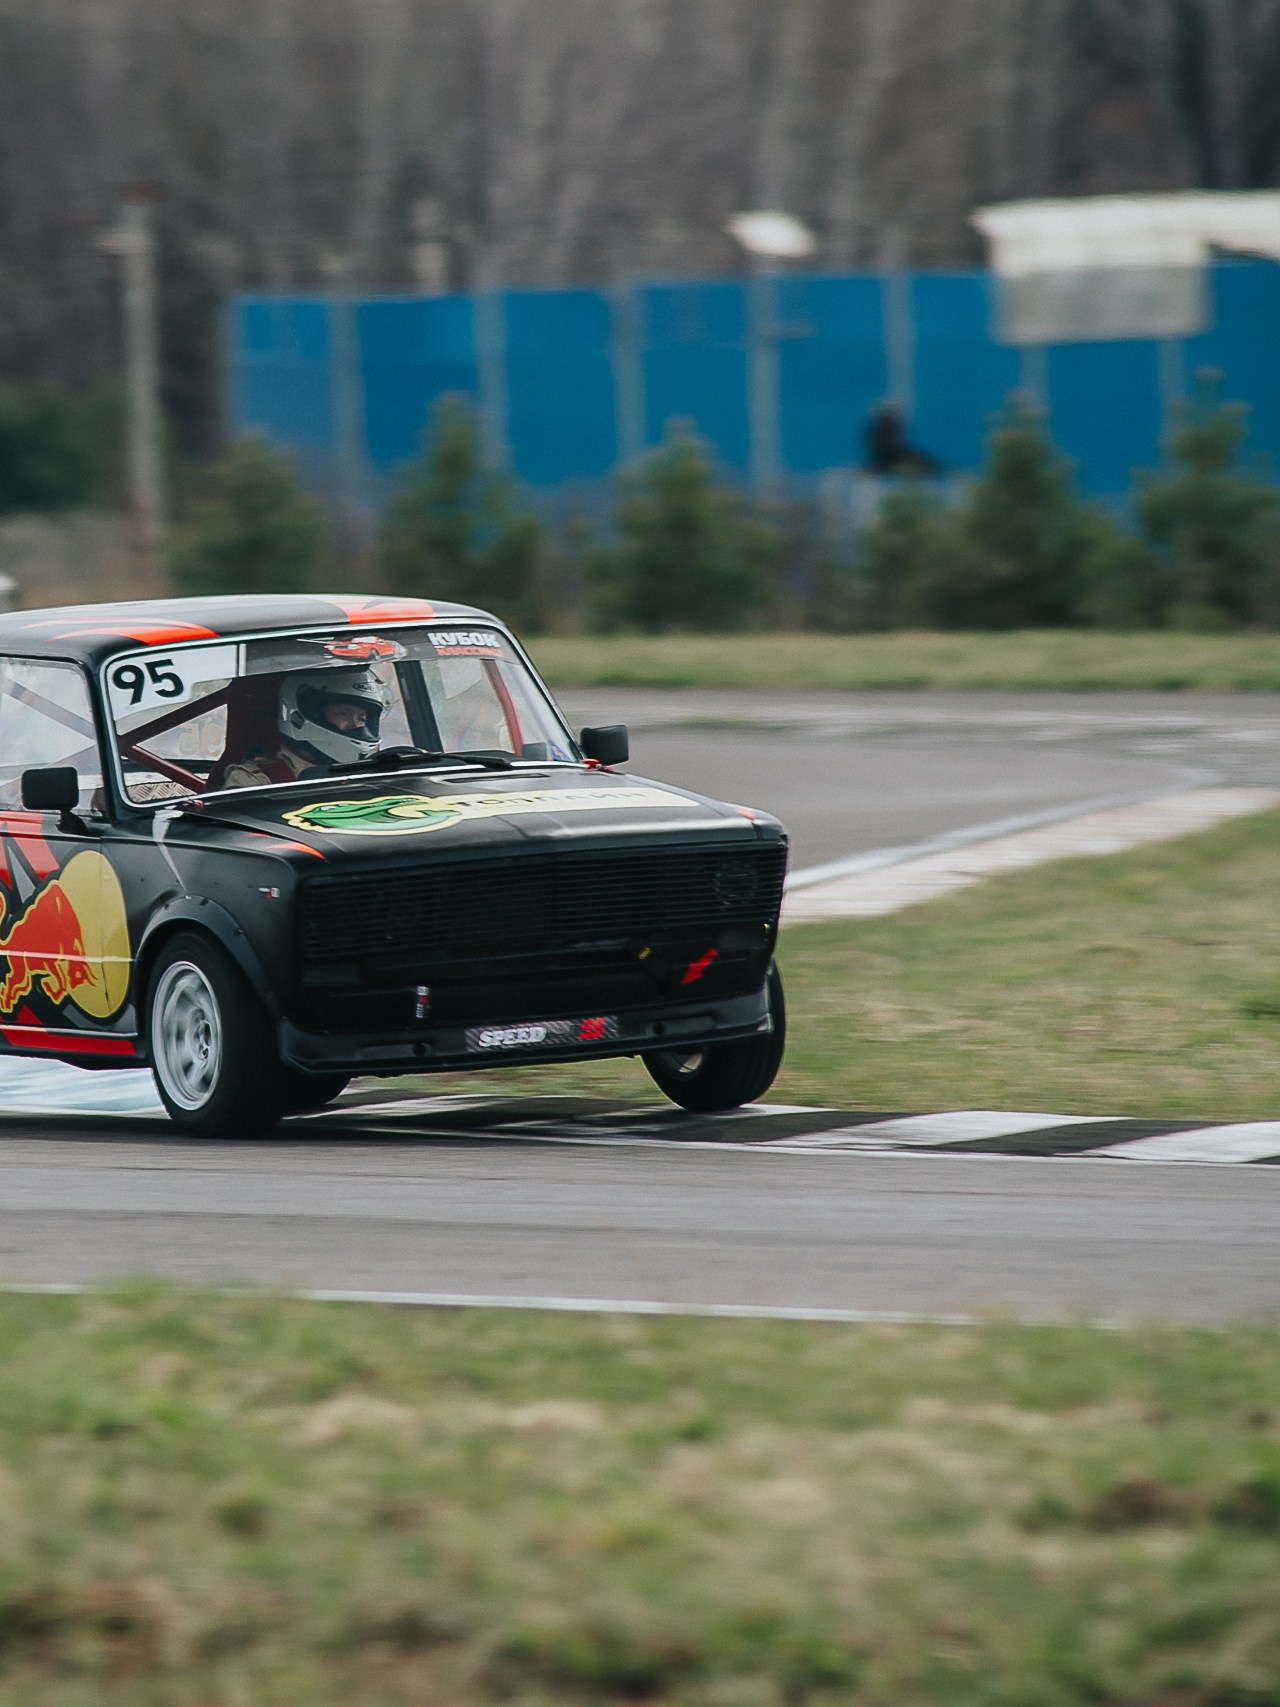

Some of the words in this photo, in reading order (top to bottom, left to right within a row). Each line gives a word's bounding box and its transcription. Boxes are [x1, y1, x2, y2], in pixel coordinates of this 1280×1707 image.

[427, 632, 500, 647] КУБОК
[112, 659, 184, 705] 95
[478, 1026, 547, 1047] SPEED
